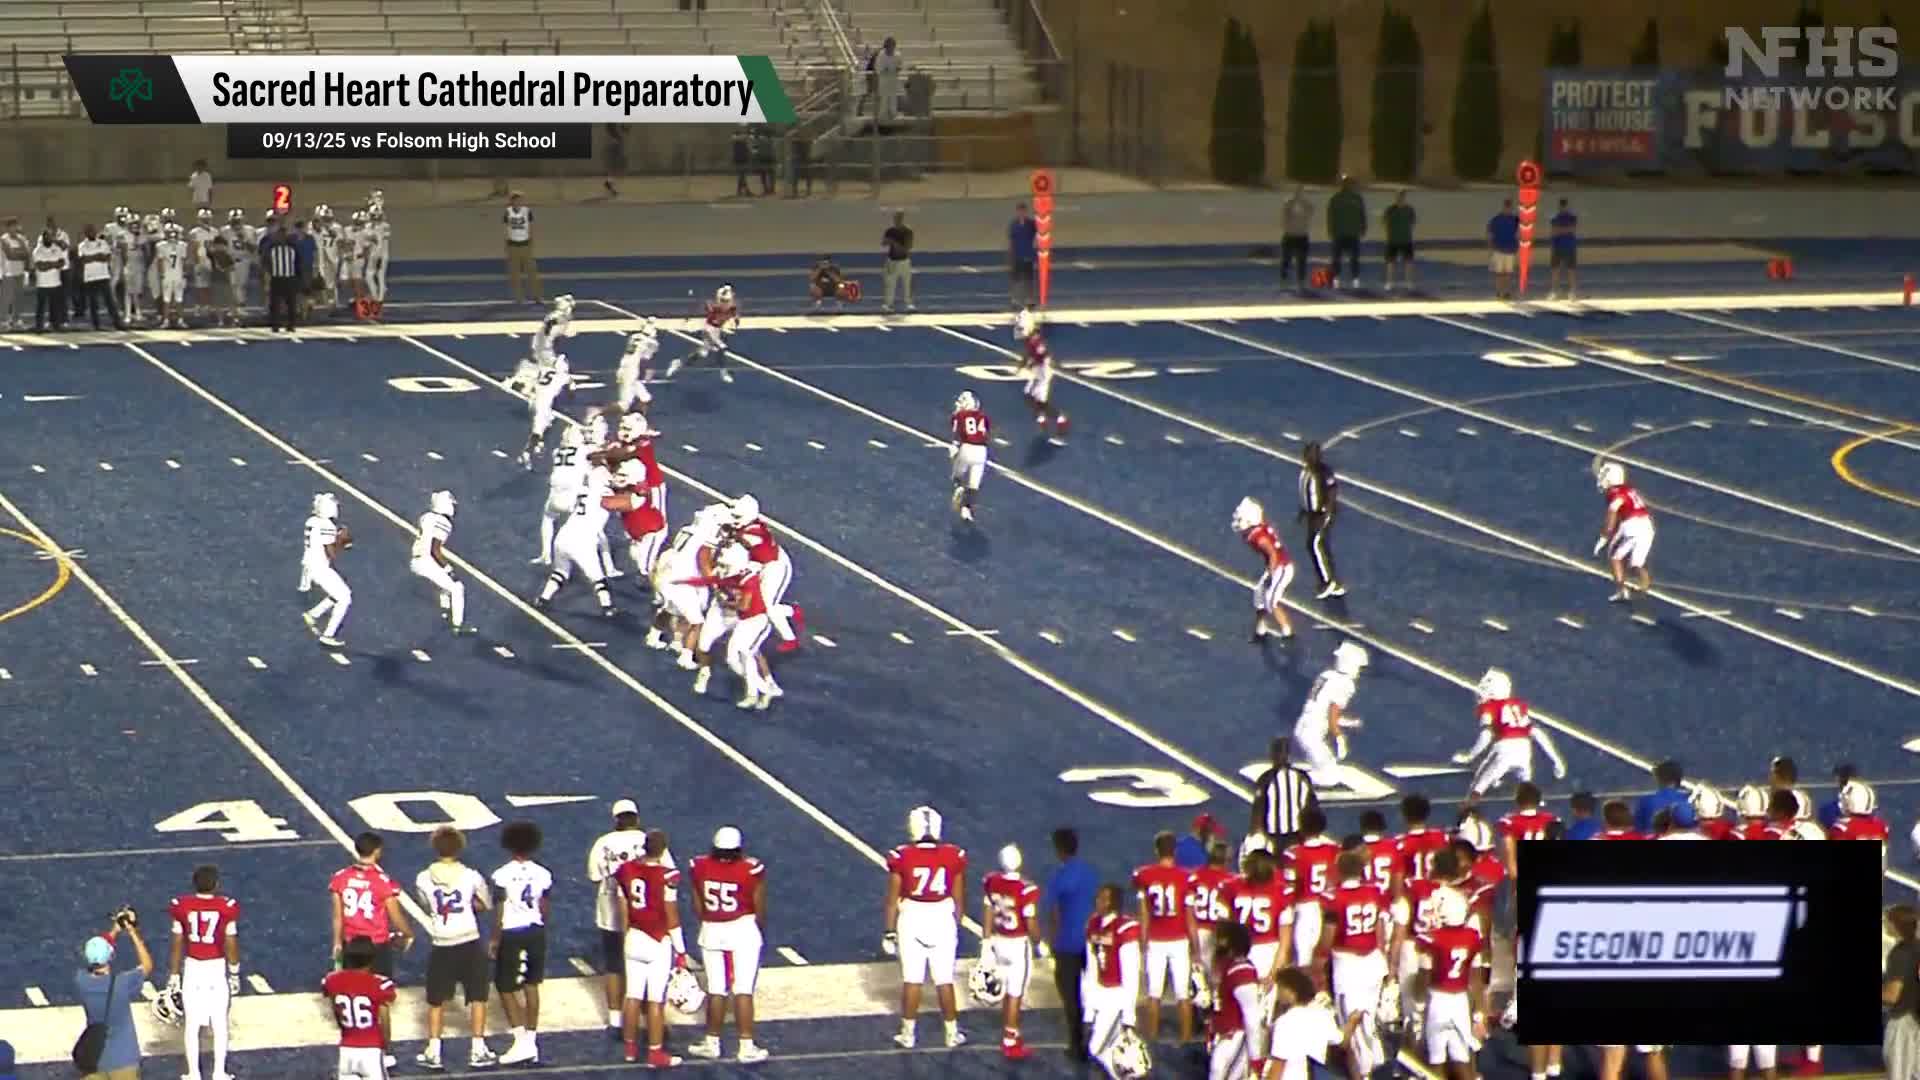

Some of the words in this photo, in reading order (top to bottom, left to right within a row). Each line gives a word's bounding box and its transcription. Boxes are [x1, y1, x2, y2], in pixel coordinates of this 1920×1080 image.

[1552, 81, 1655, 107] PROTECT
[276, 187, 289, 209] 2
[965, 417, 986, 435] 84
[631, 878, 647, 909] 9
[912, 867, 946, 896] 74
[1310, 864, 1327, 893] 5
[342, 887, 374, 919] 94
[703, 880, 738, 912] 55
[1149, 885, 1176, 917] 31
[1195, 886, 1229, 921] 26
[186, 910, 221, 943] 17
[1235, 896, 1270, 933] 75
[1346, 902, 1377, 936] 52
[1553, 930, 1663, 960] SECOND
[1672, 930, 1756, 960] DOWN
[1448, 948, 1467, 978] 7
[336, 995, 373, 1030] 36
